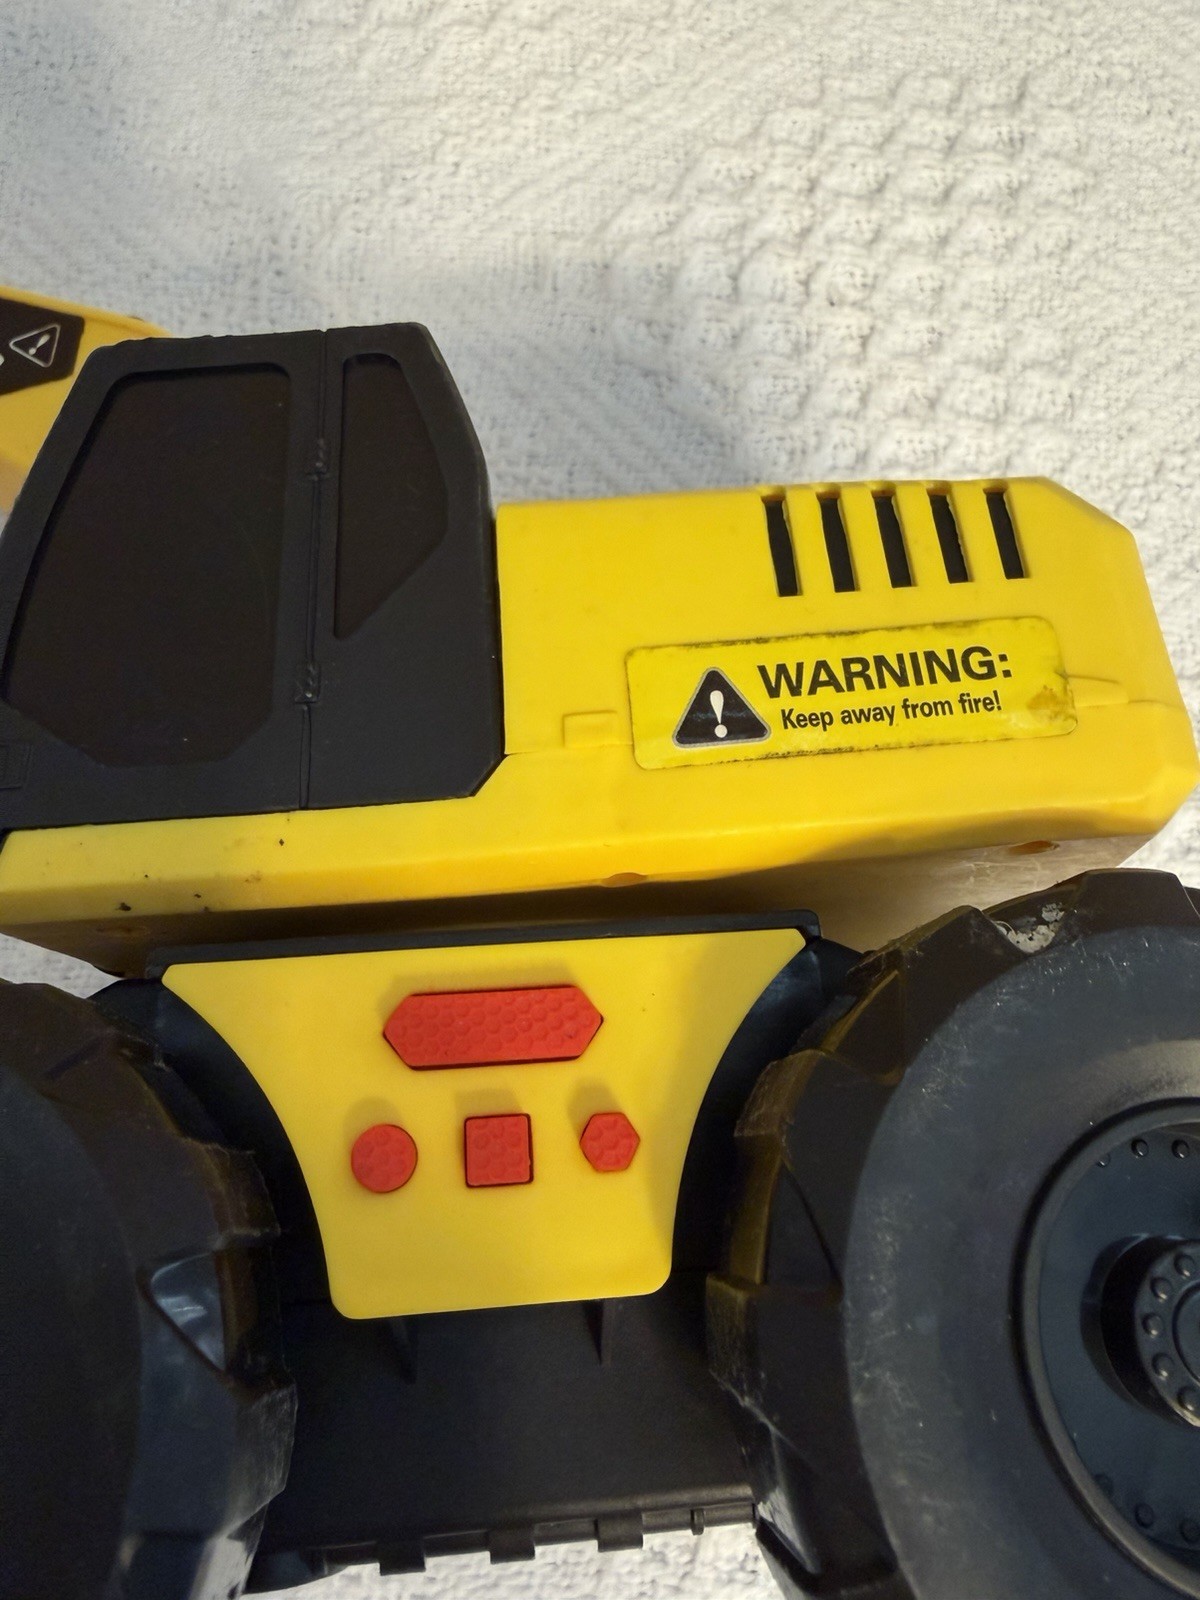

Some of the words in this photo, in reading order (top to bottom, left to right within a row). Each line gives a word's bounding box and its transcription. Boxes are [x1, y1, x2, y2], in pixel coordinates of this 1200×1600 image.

[757, 646, 1012, 699] WARNING:
[781, 708, 834, 731] Keep
[840, 705, 896, 727] away
[902, 697, 953, 719] from
[959, 691, 1002, 714] fire!
